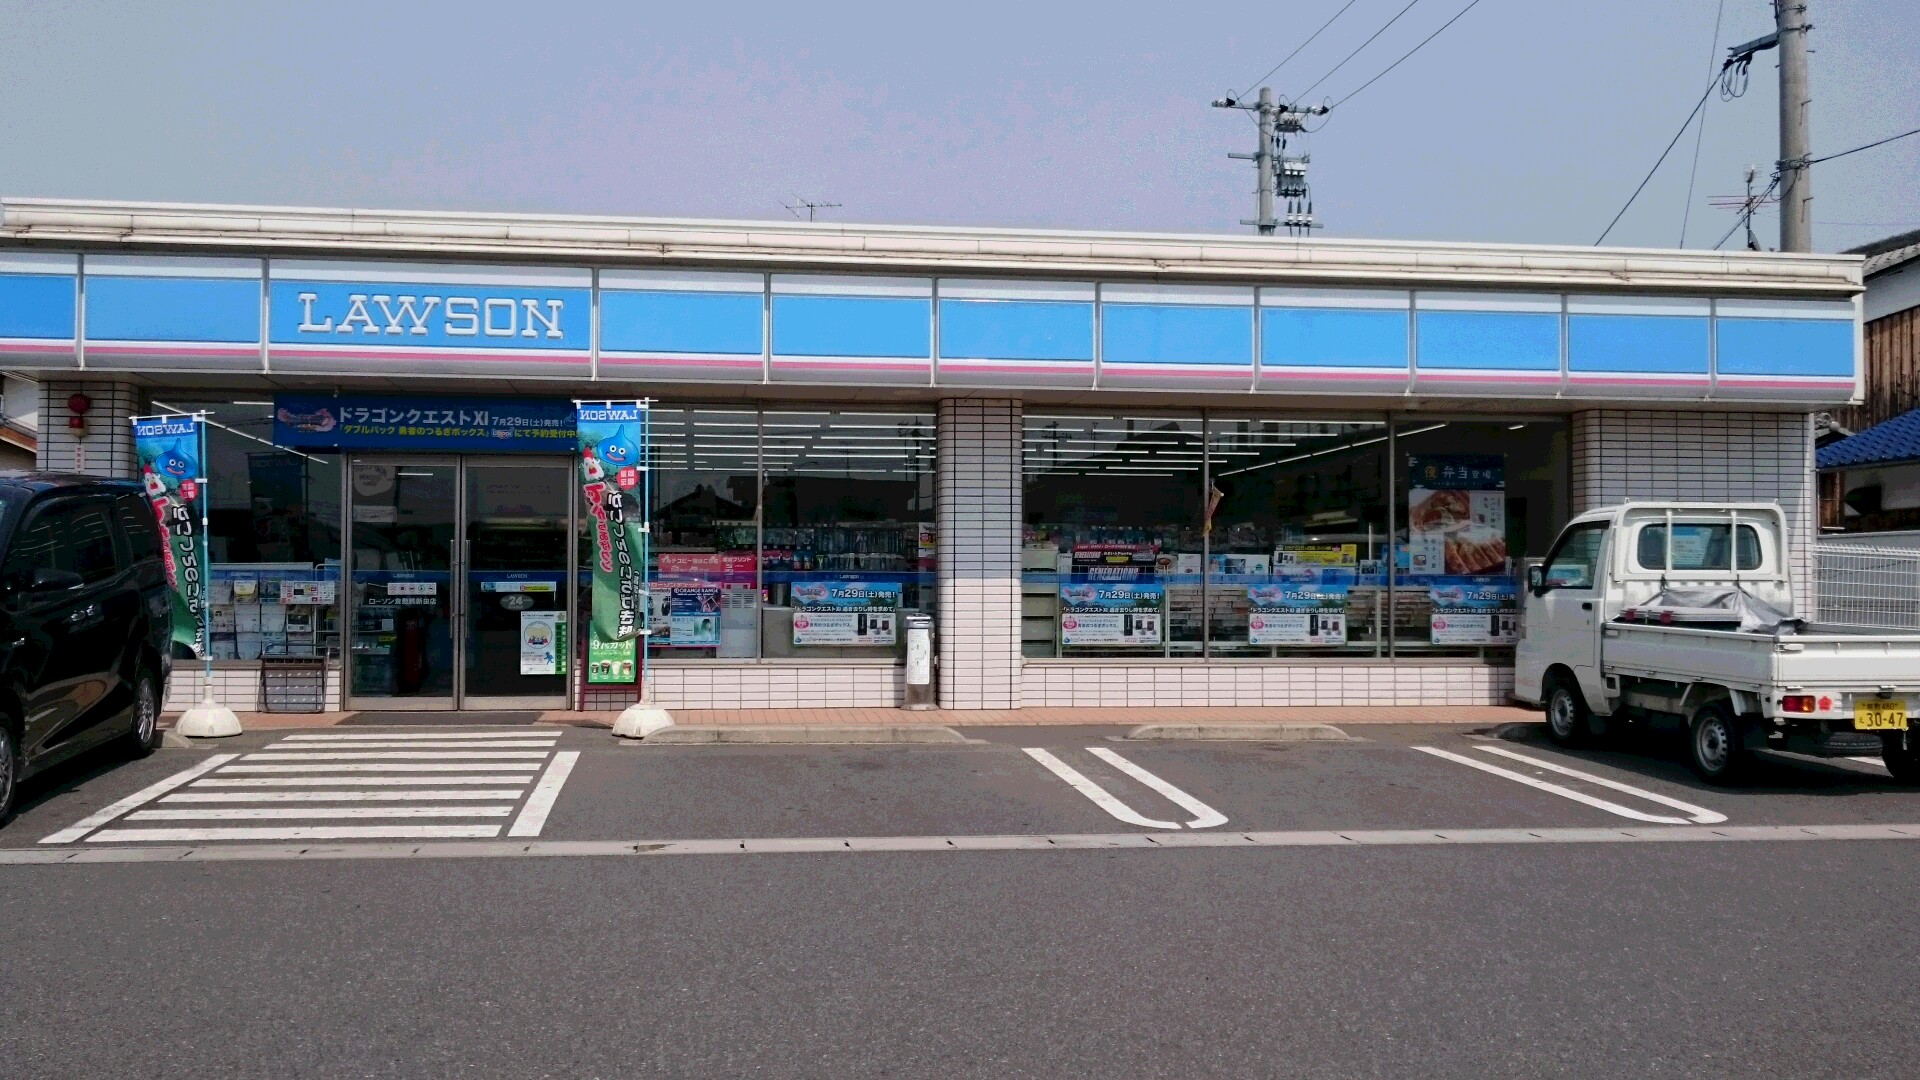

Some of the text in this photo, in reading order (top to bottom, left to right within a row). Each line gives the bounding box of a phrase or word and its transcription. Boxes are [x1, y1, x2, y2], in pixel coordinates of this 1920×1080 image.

[299, 293, 563, 338] LAWSON
[339, 407, 489, 426] ドラゴンクエストXI
[508, 595, 523, 605] 24
[1866, 712, 1903, 727] 30-47
